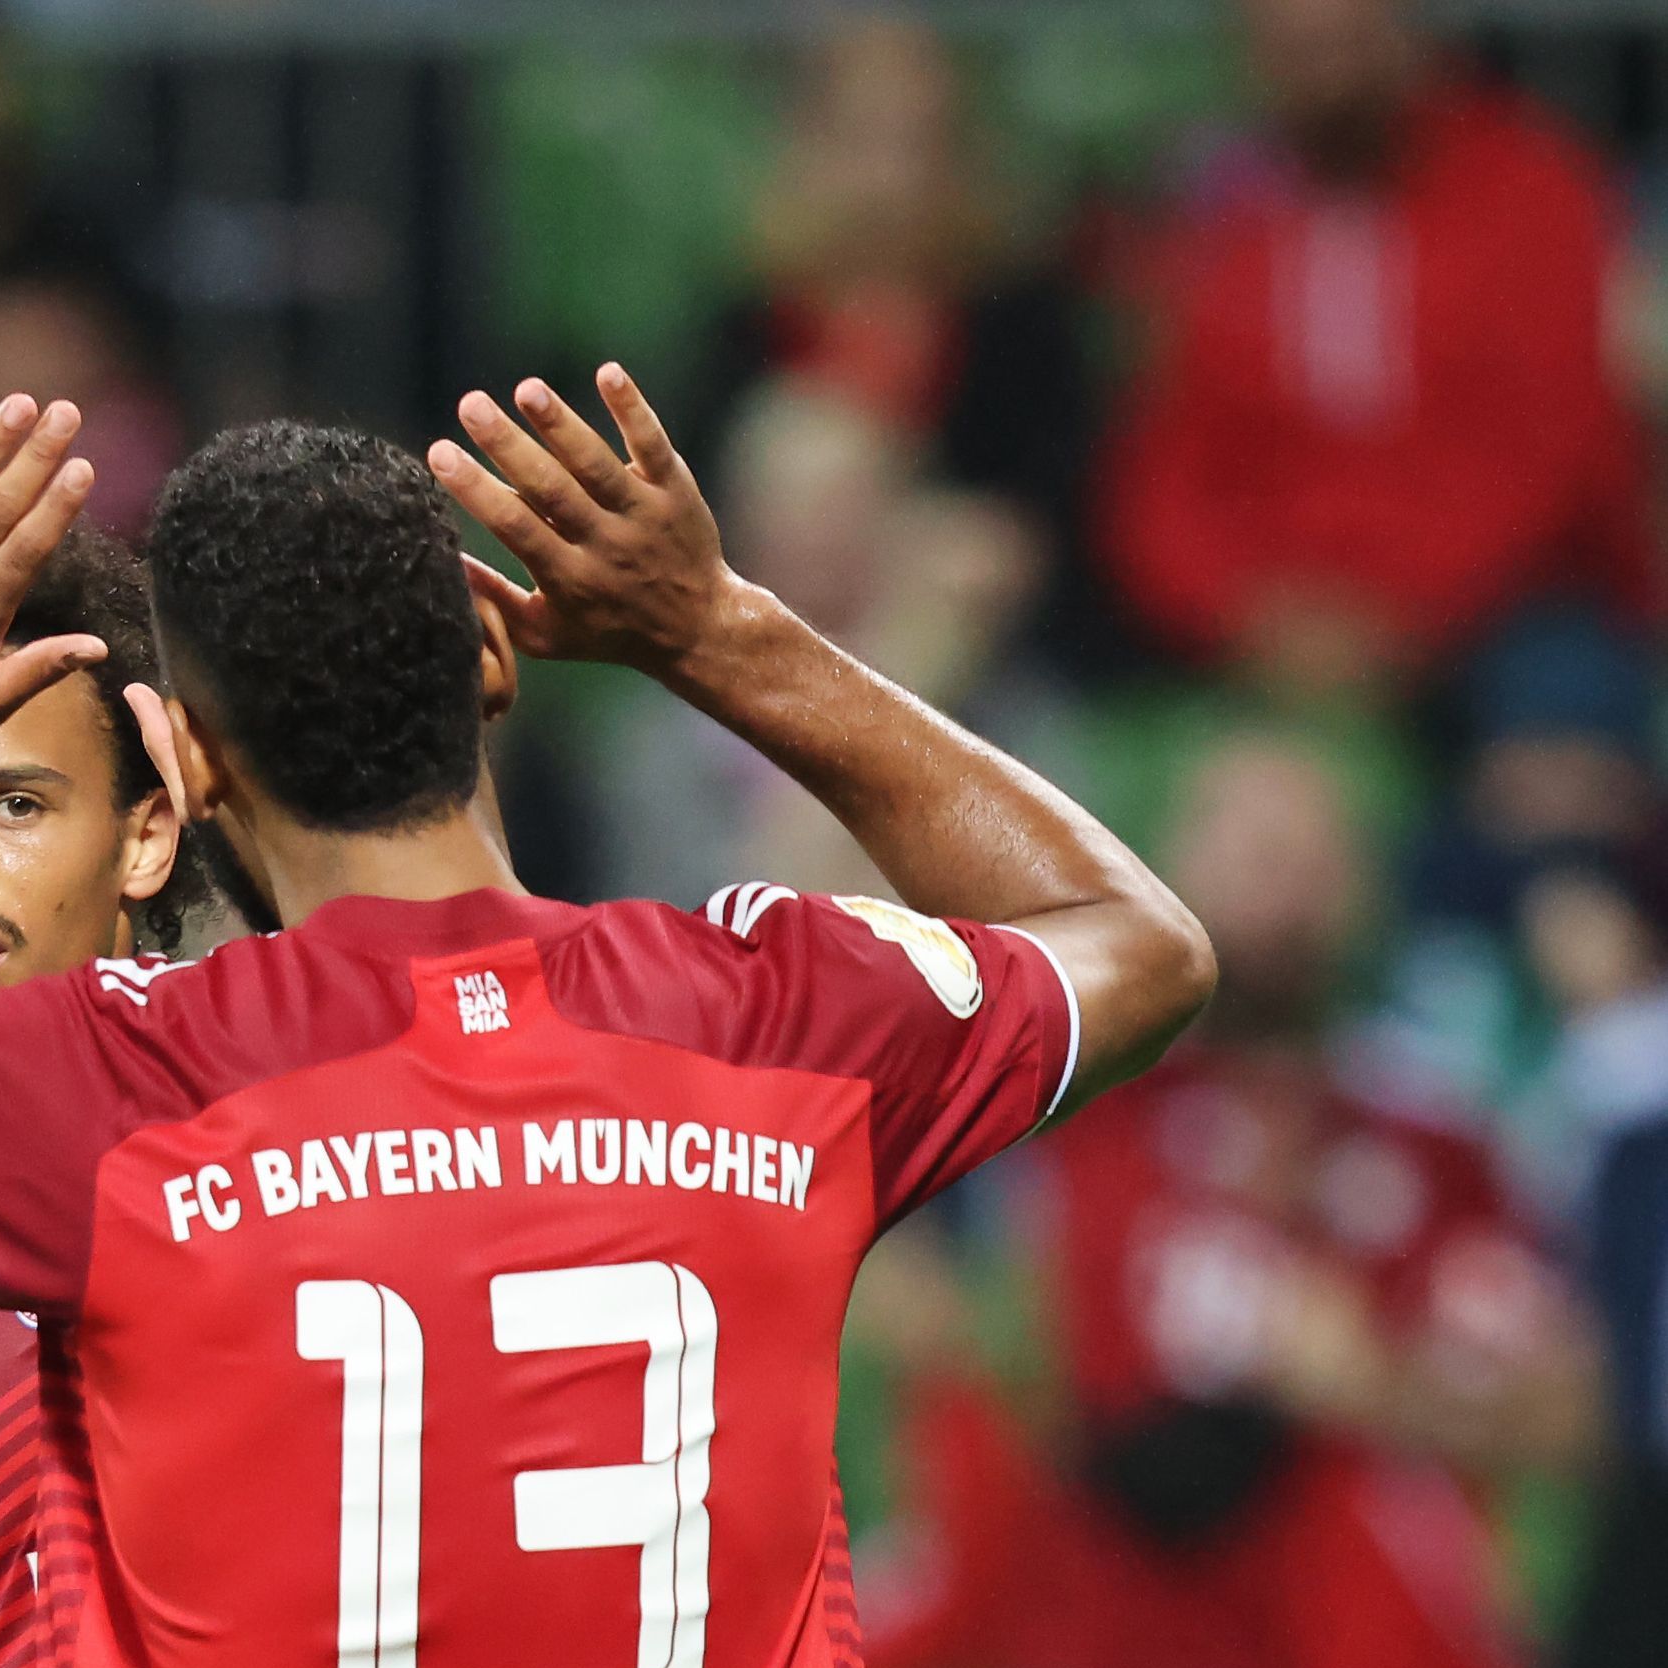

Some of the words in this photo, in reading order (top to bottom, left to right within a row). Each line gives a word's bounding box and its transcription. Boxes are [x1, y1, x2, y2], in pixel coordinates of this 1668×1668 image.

[454, 970, 501, 998] MIA
[458, 989, 508, 1017] SAN
[461, 1009, 511, 1034] MIA
[162, 1163, 242, 1243] FC
[251, 1126, 502, 1217] BAYERN
[522, 1118, 815, 1211] MÜNCHEN
